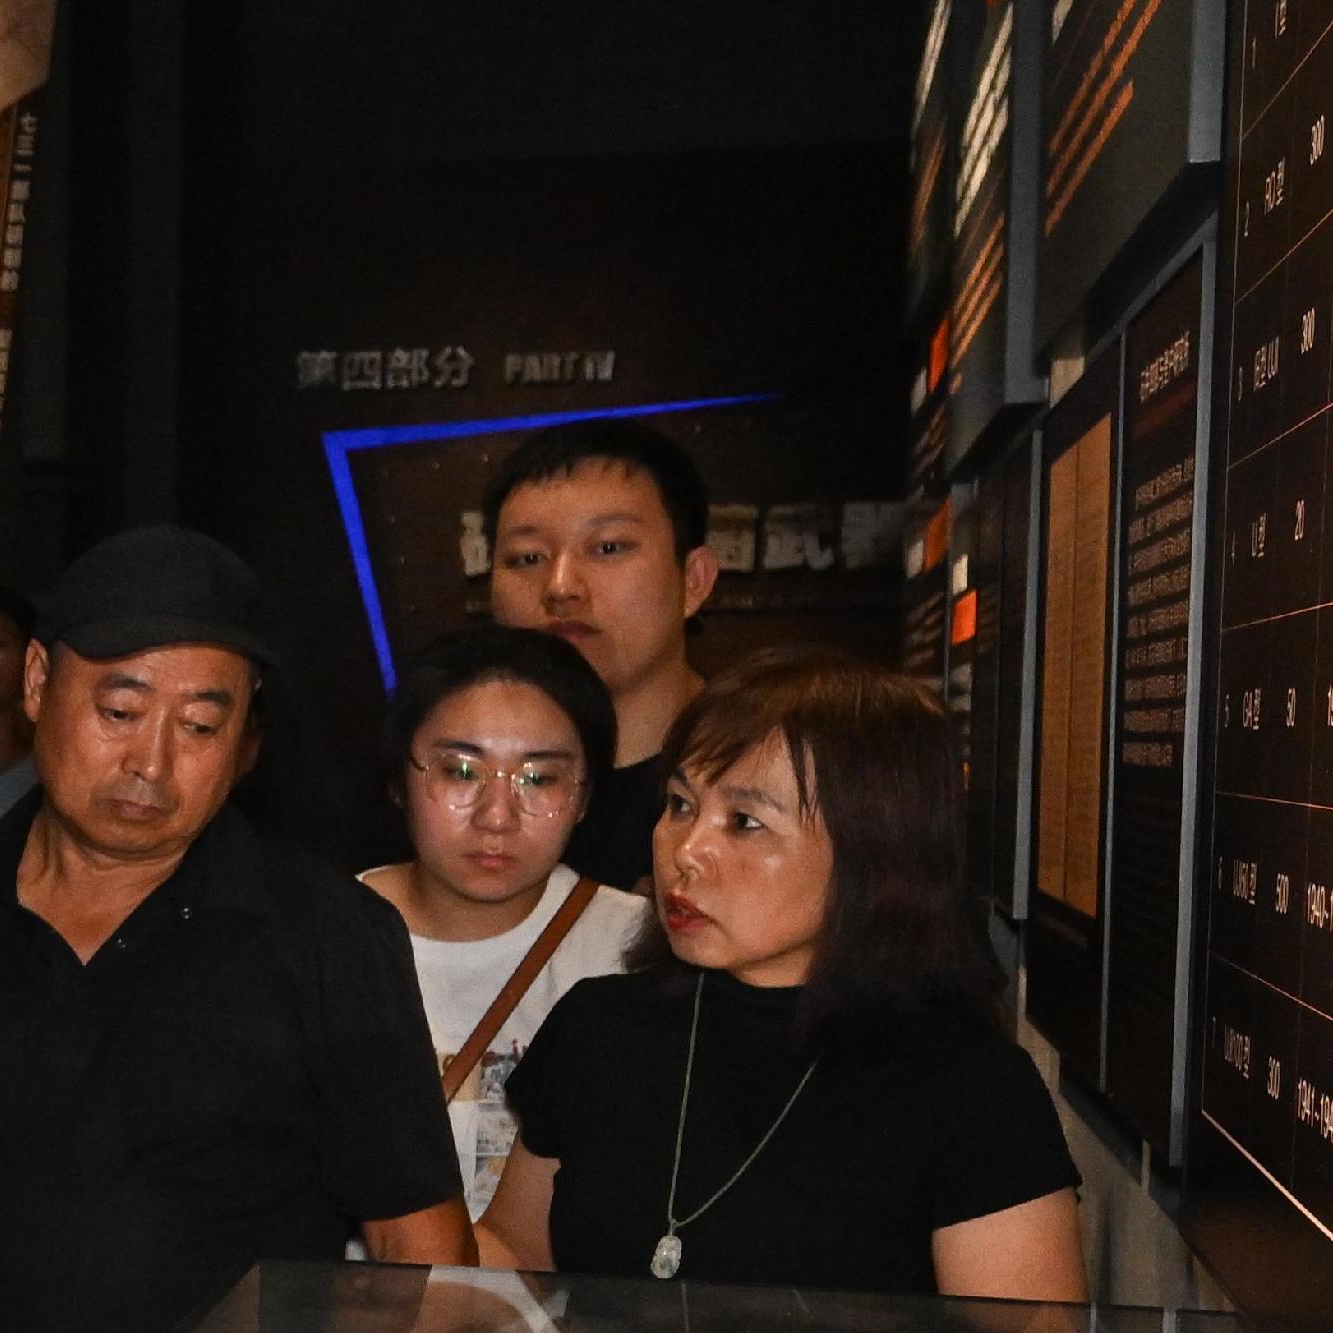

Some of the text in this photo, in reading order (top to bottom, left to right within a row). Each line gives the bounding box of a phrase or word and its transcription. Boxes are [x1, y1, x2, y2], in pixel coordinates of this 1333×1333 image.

[1309, 113, 1325, 166] 300
[1300, 307, 1316, 355] 300
[295, 345, 474, 391] 第四部分
[505, 351, 578, 383] PART
[1293, 499, 1306, 541] 20
[1285, 687, 1297, 728] 50
[1274, 872, 1290, 914] 500
